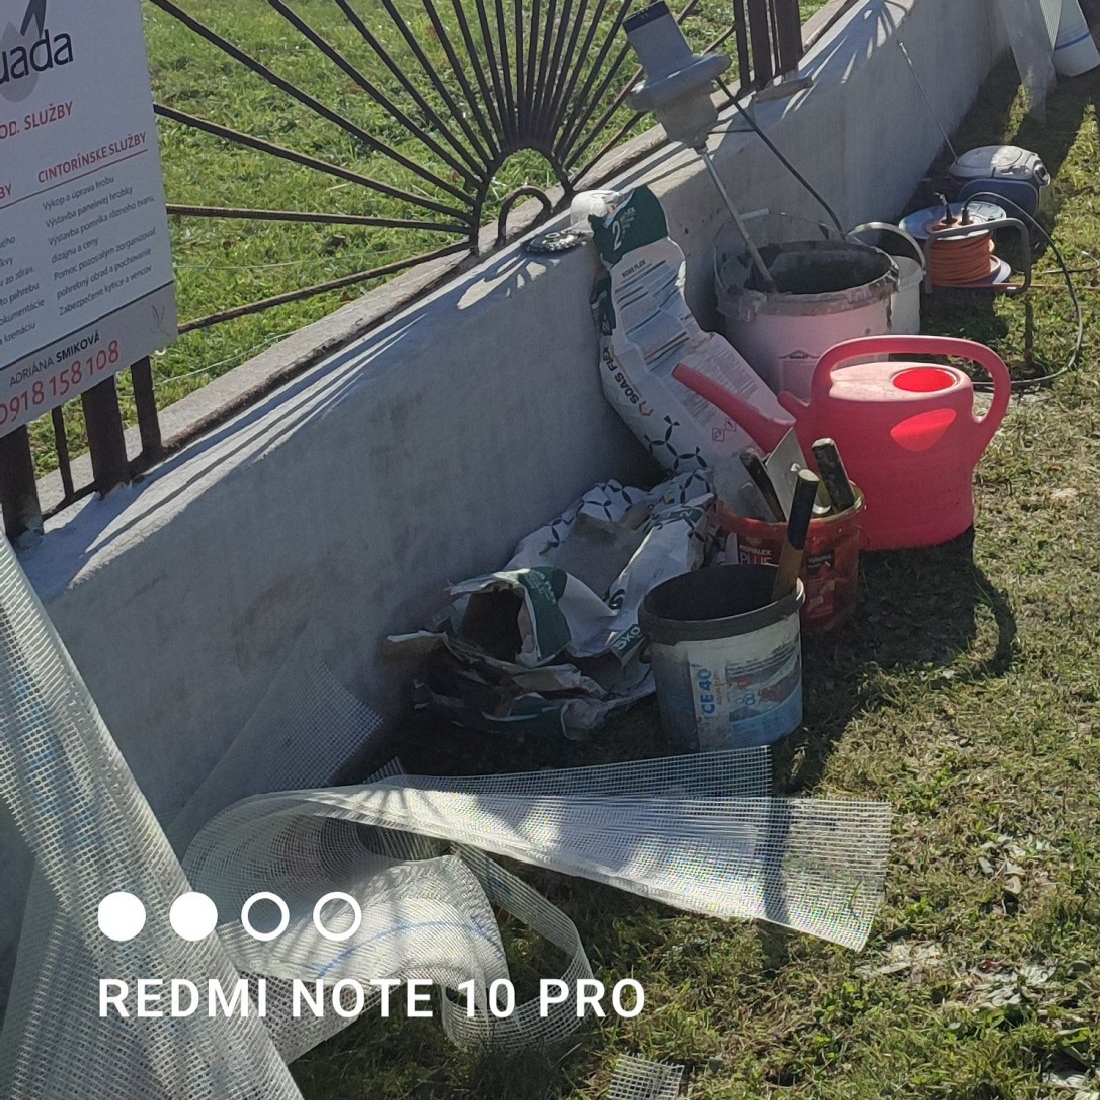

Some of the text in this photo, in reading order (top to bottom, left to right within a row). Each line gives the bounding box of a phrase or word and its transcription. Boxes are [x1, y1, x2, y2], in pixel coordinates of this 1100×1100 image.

[24, 100, 73, 131] SLUŽBY
[38, 131, 147, 183] CINTORÍNSKE SLUŽBY
[0, 339, 119, 426] 0918 158 108
[697, 668, 716, 714] CE 40
